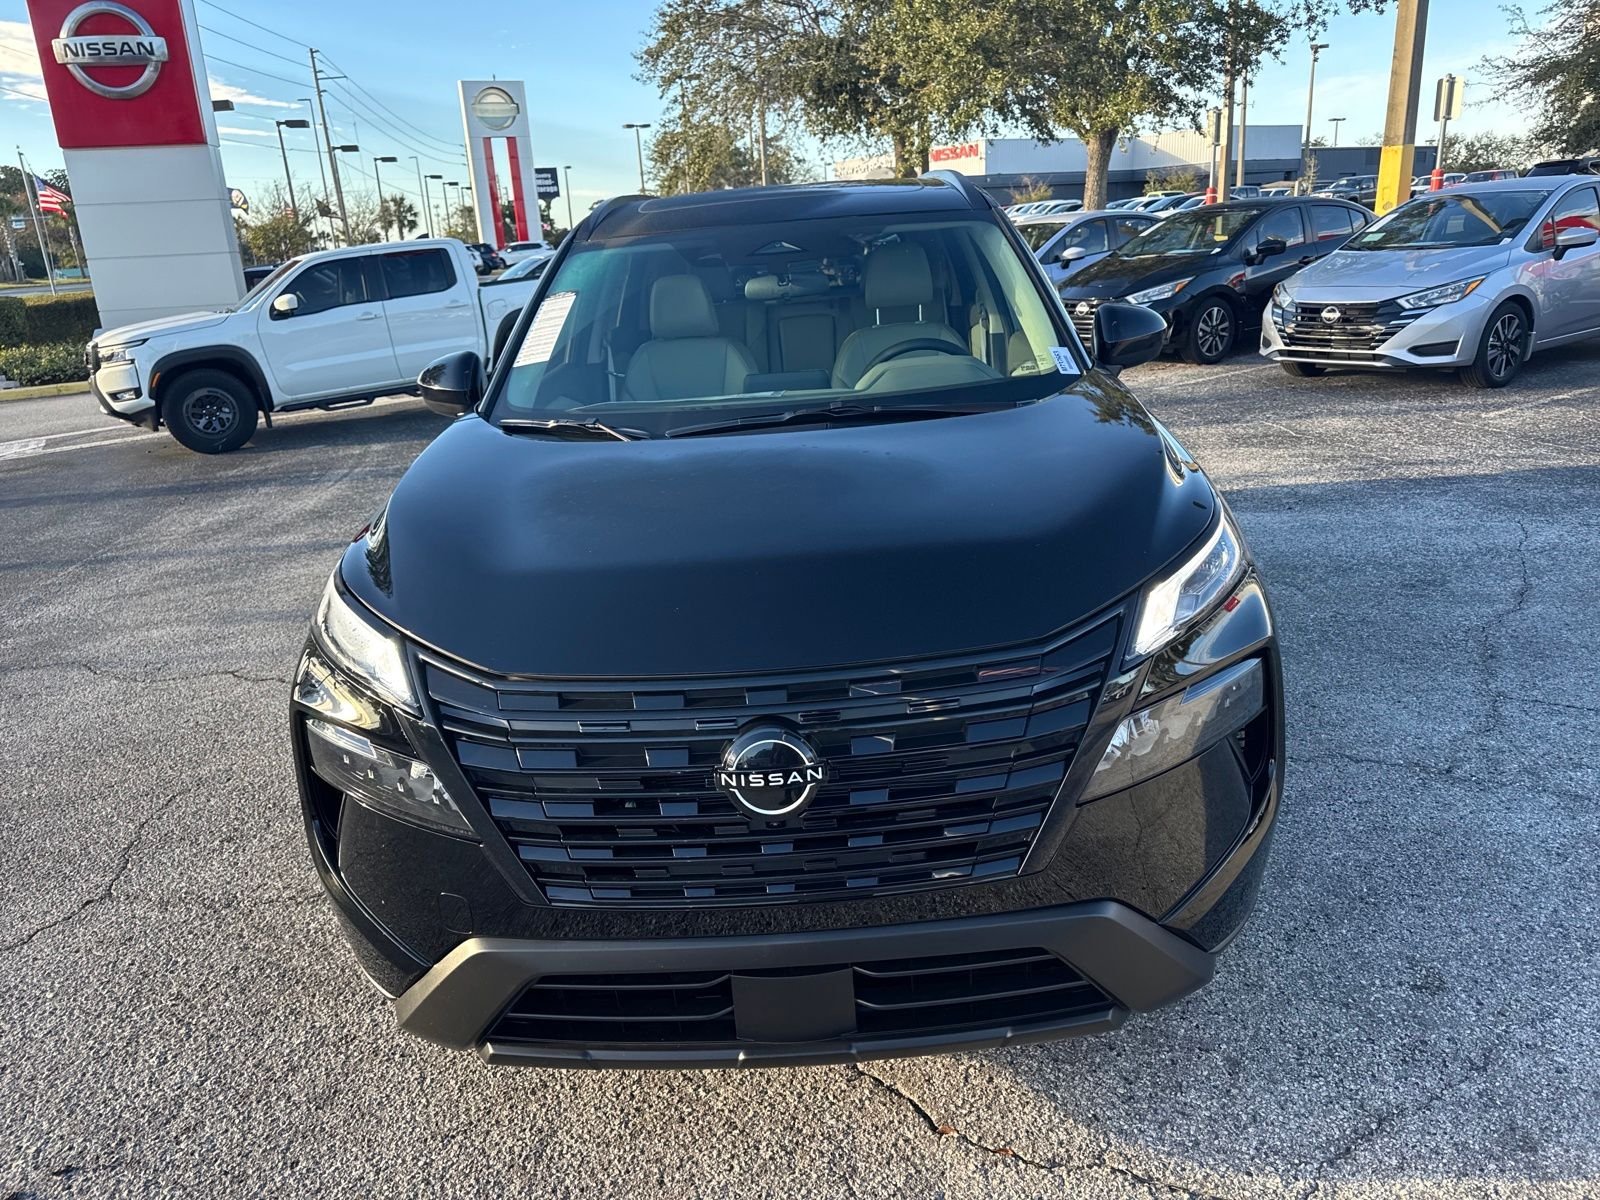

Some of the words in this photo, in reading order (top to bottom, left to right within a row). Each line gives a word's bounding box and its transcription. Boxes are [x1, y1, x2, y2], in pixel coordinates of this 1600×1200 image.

[63, 41, 155, 58] NISSAN
[931, 143, 978, 162] NISSAN
[720, 766, 822, 787] NISSAN
